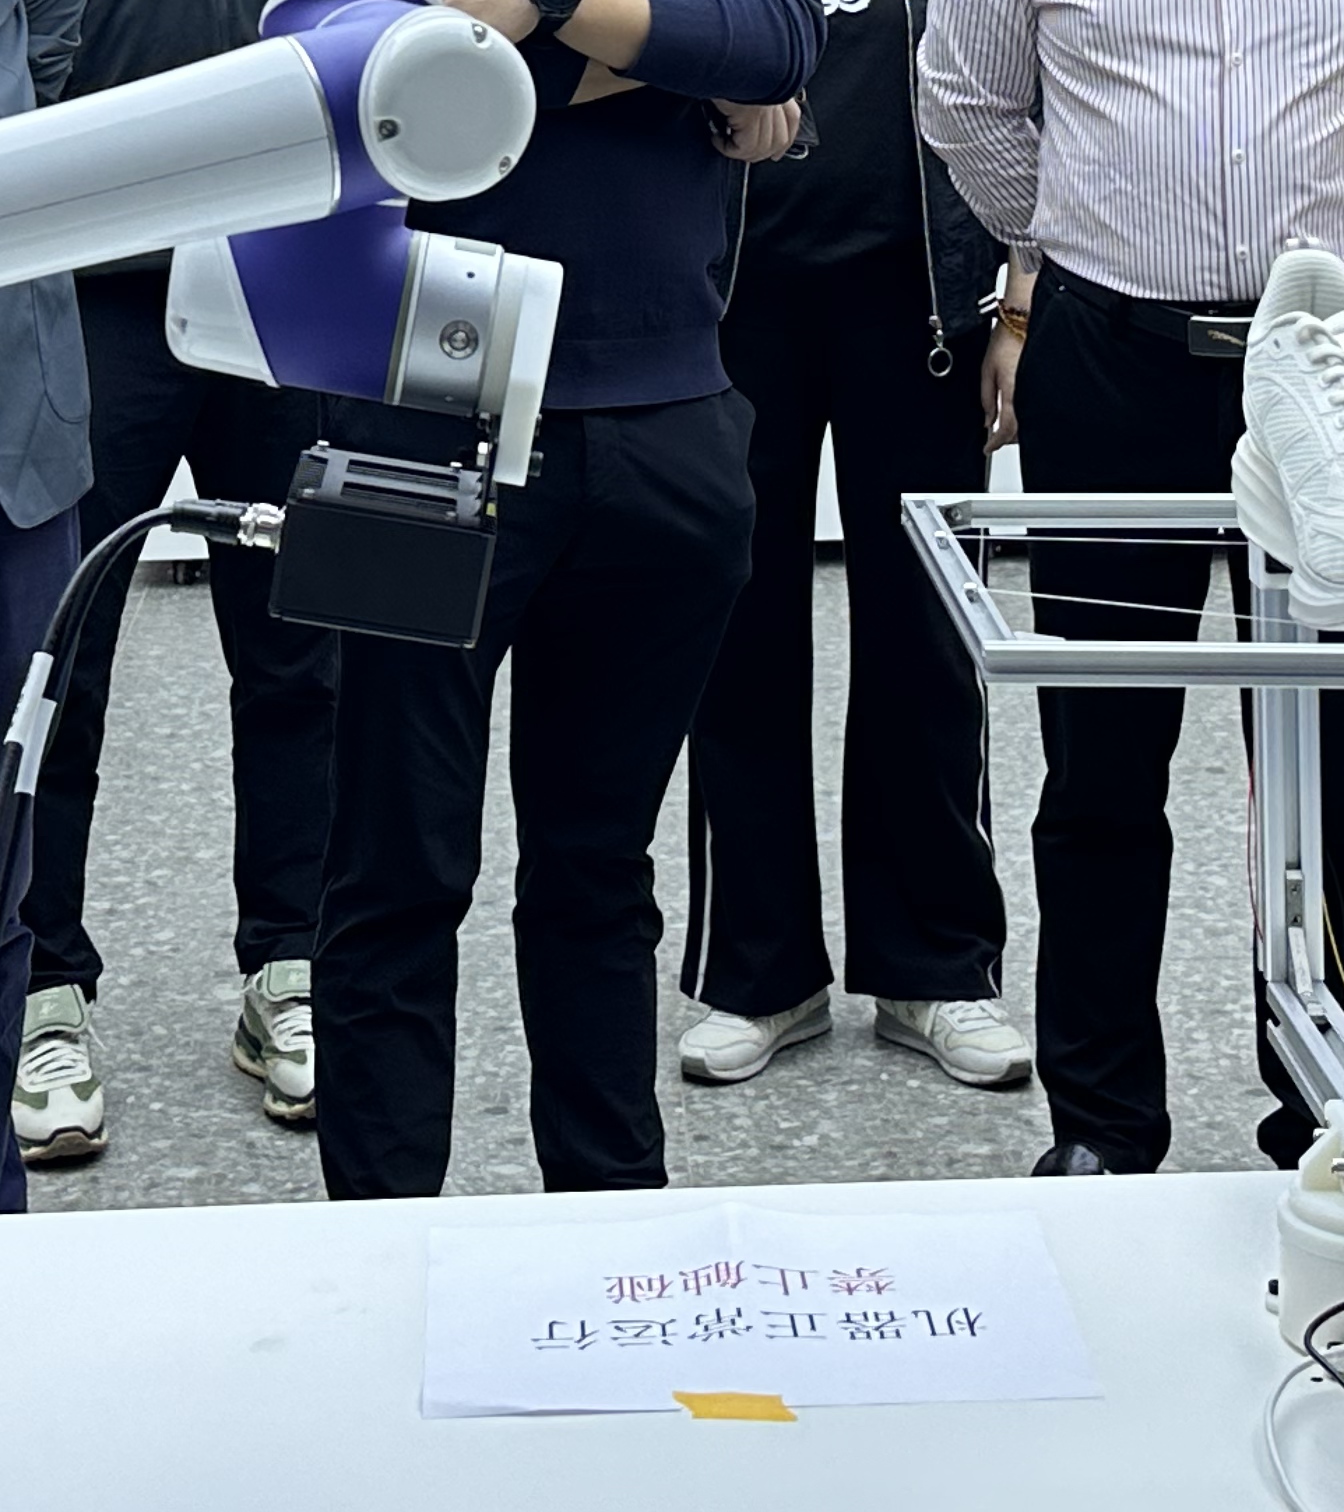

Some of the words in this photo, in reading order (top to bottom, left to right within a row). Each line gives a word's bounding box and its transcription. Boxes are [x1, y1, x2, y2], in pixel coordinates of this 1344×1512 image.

[603, 1261, 896, 1304] 禁止触碰
[531, 1307, 987, 1351] 机器正常运行
